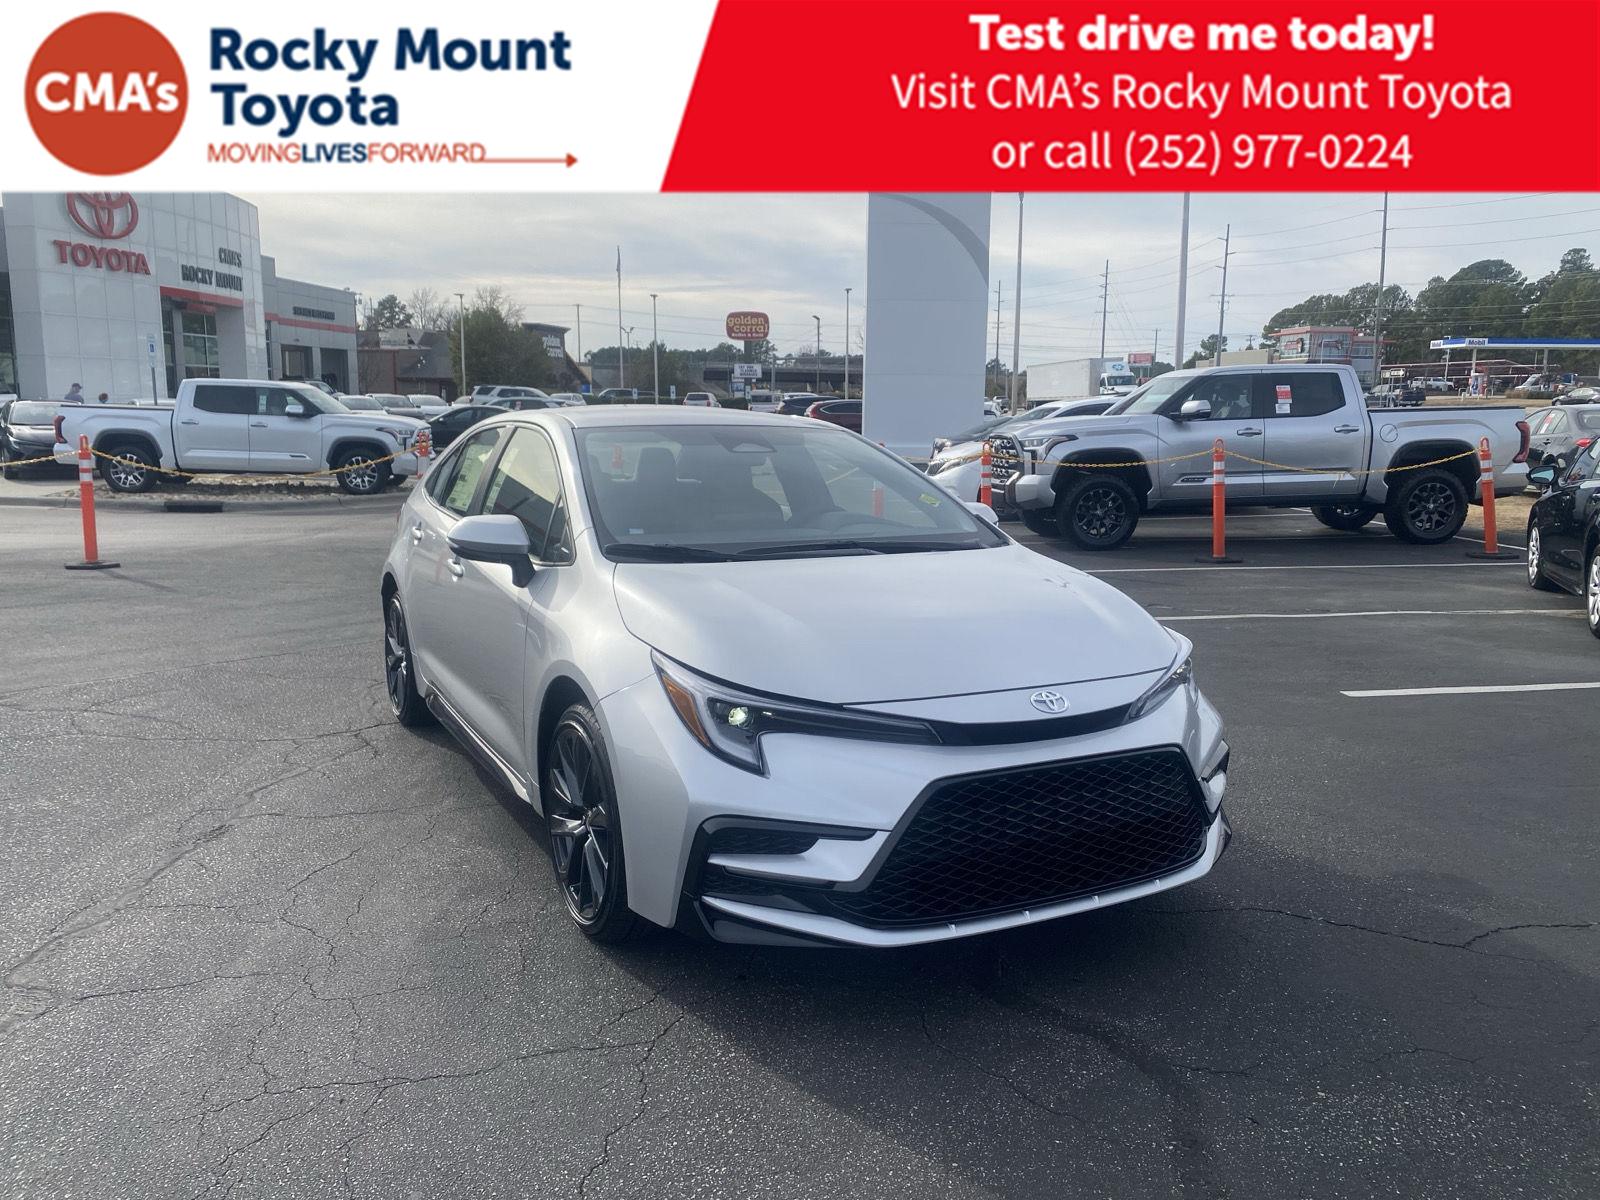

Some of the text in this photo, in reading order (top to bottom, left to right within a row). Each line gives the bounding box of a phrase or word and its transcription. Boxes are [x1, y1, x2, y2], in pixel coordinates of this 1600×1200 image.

[53, 239, 152, 276] TOYOTA
[181, 263, 243, 292] ROCKY MOUNT
[728, 316, 764, 326] golden
[733, 324, 768, 332] corral
